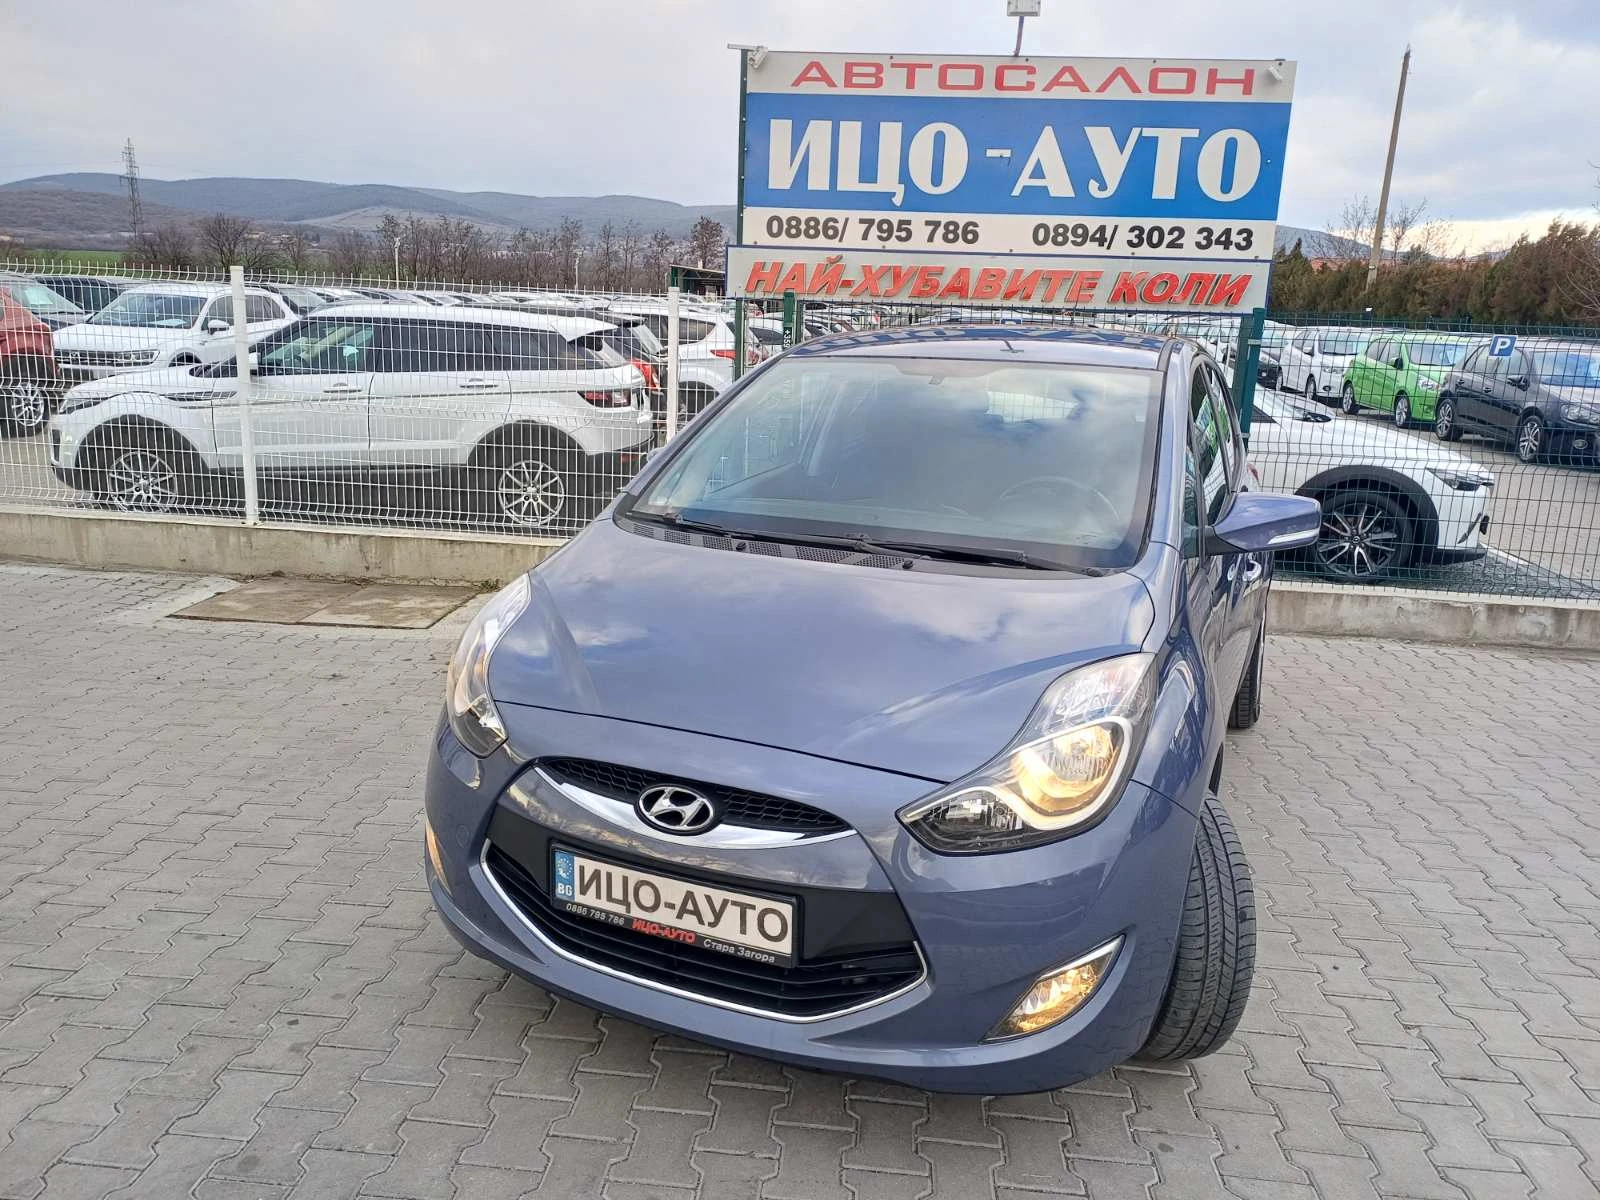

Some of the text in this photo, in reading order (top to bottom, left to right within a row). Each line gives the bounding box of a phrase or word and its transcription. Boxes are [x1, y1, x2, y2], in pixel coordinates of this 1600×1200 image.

[791, 60, 1255, 96] АВТОСАЛОН
[766, 215, 1254, 251] 0886/ 795 786 0894/ 302 343
[745, 254, 1253, 306] НАЙ-ХУБАВИТЕ КОЛИ
[1494, 337, 1511, 355] P
[557, 883, 573, 897] BG
[578, 864, 789, 943] ИЦО-АУТО
[589, 909, 606, 920] 795
[608, 914, 625, 926] 786
[703, 938, 735, 954] Стара
[737, 946, 775, 963] Загора
